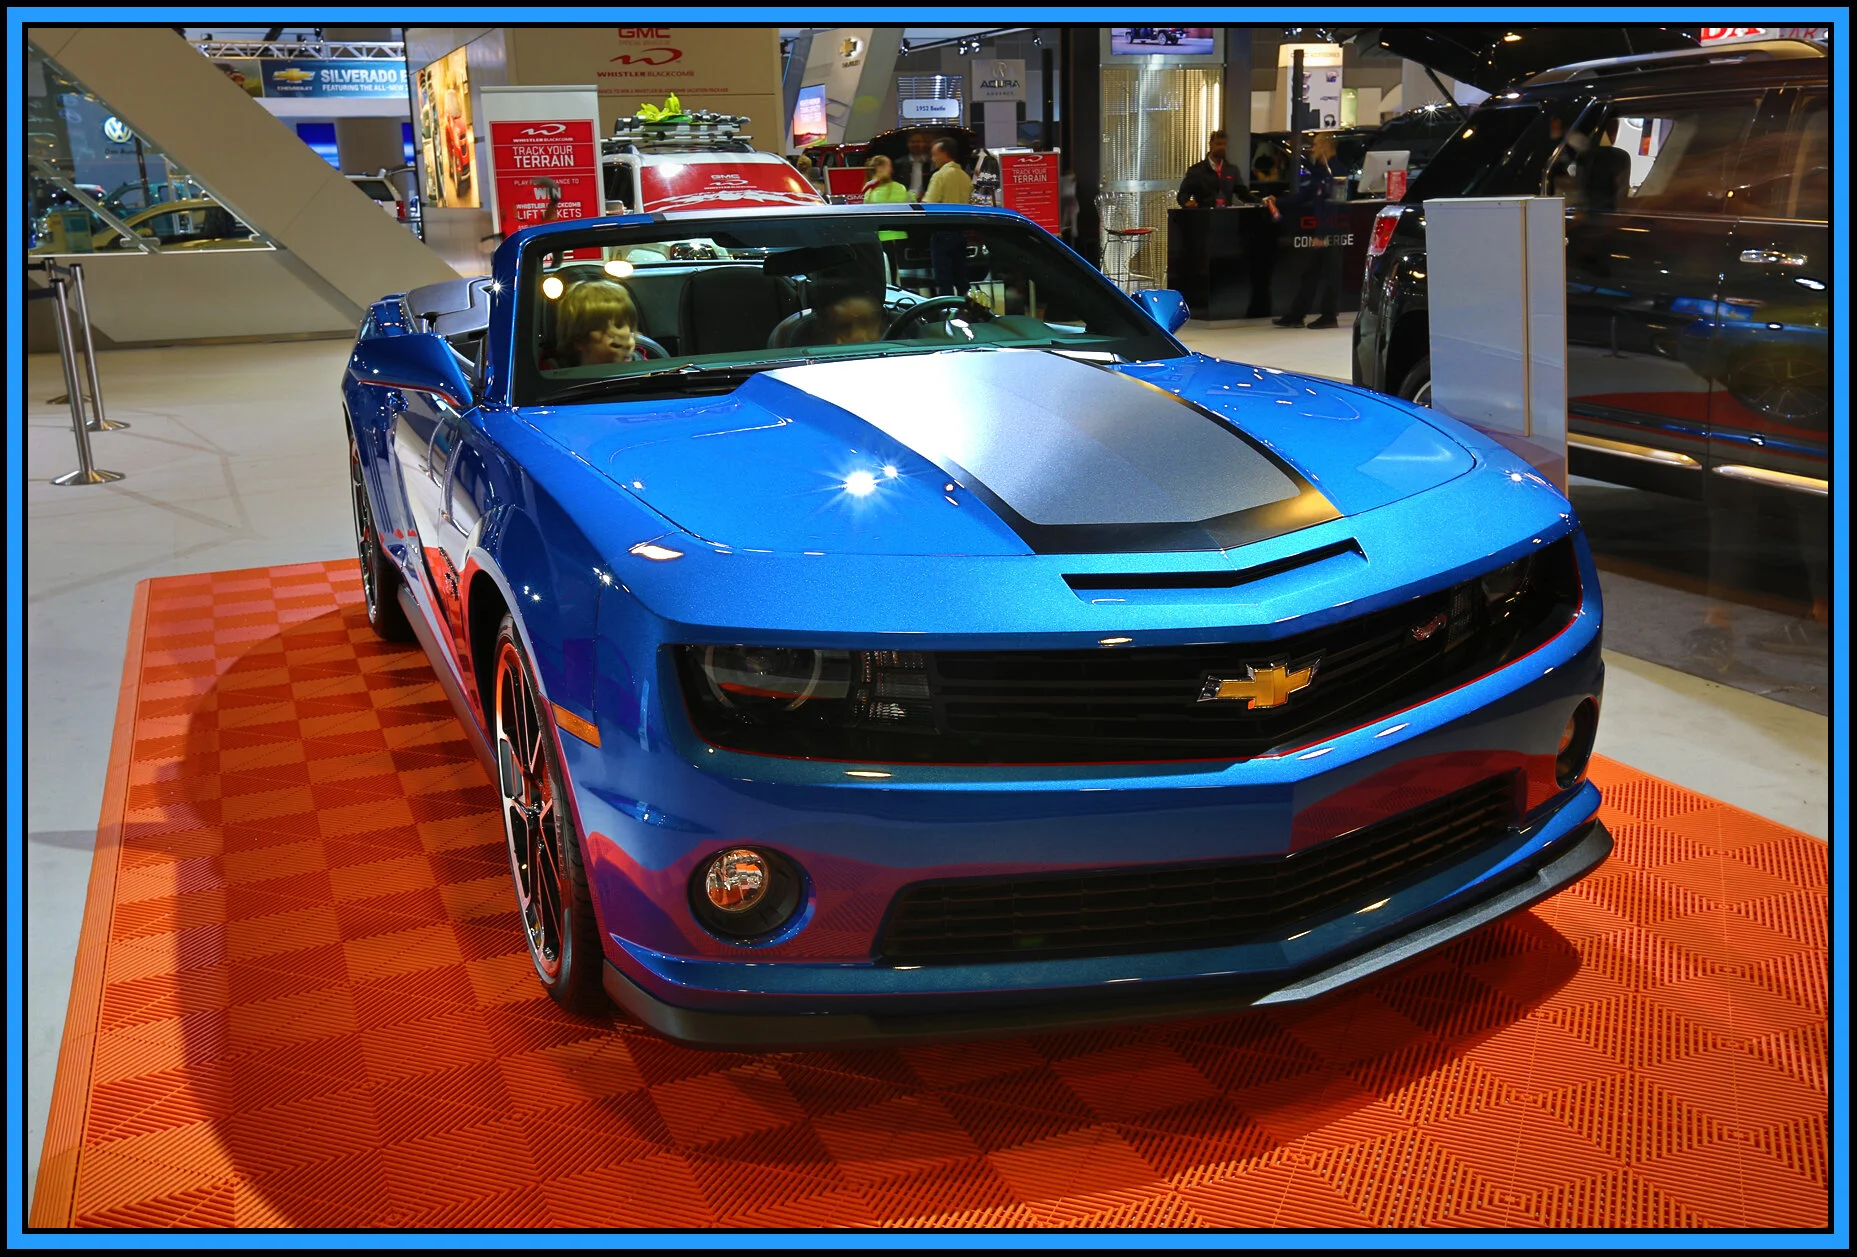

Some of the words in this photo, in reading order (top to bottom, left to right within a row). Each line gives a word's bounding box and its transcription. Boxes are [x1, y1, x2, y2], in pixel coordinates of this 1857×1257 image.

[618, 27, 671, 39] GMC
[320, 69, 397, 83] SILVERADO
[322, 84, 360, 92] FEATURING
[980, 80, 1021, 89] ACURA
[512, 146, 545, 156] TRACK
[547, 145, 574, 155] YOUR
[513, 154, 574, 168] TERRAIN
[1012, 174, 1048, 184] TERRAIN
[516, 209, 539, 220] LIFT
[540, 208, 582, 219] TKETS
